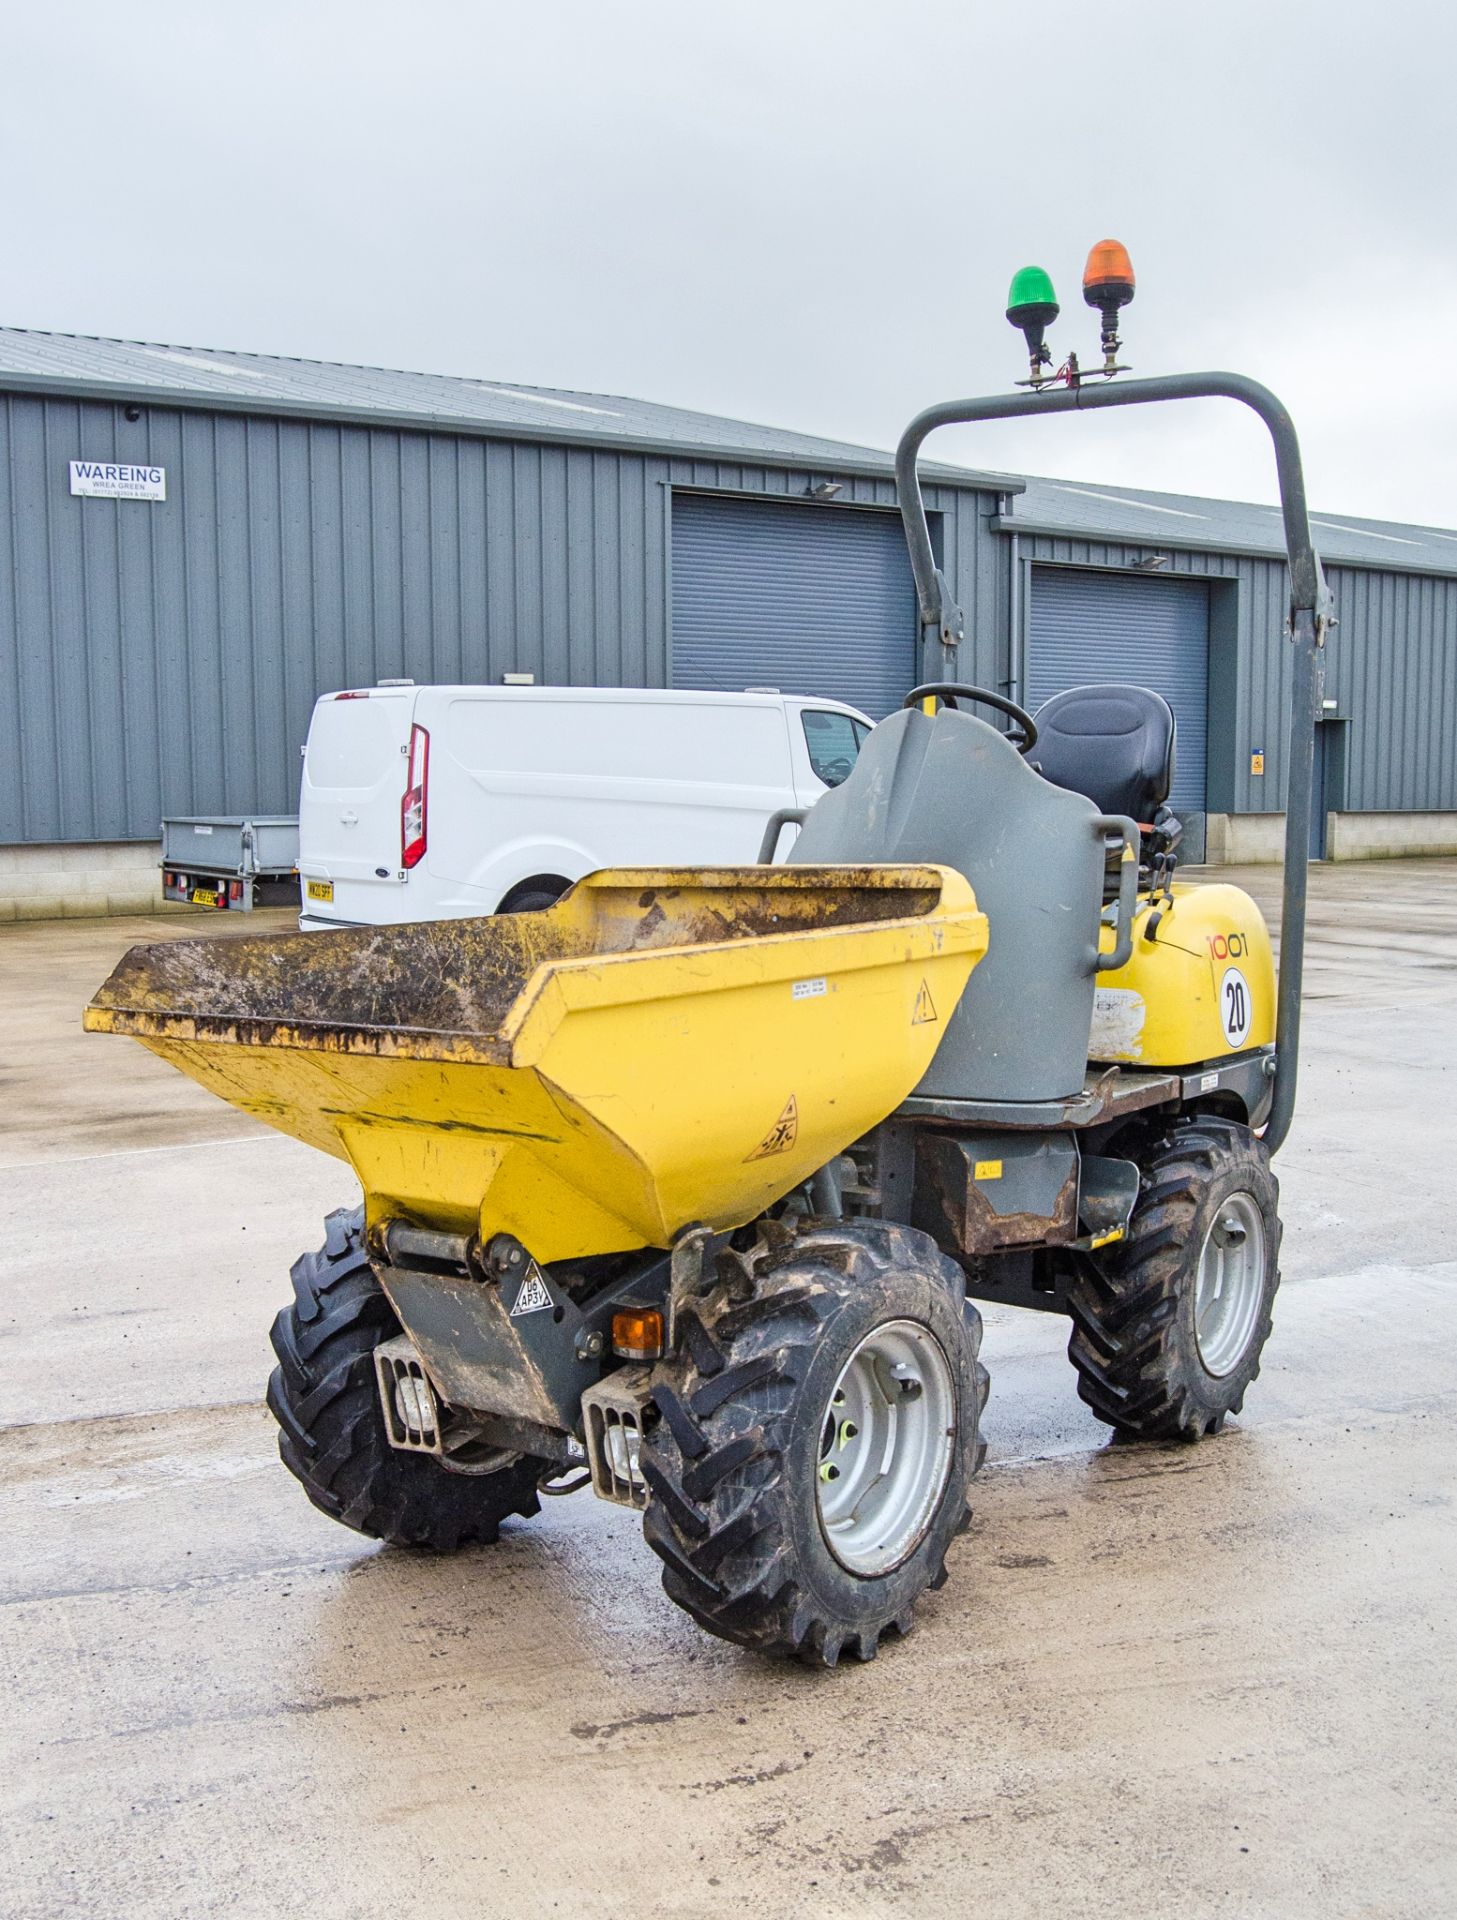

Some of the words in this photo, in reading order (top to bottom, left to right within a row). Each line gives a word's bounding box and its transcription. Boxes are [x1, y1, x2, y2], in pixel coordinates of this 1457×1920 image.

[75, 463, 161, 483] WAREING
[118, 482, 145, 490] GREEN
[1206, 933, 1248, 960] 1001
[1226, 982, 1245, 1033] 20
